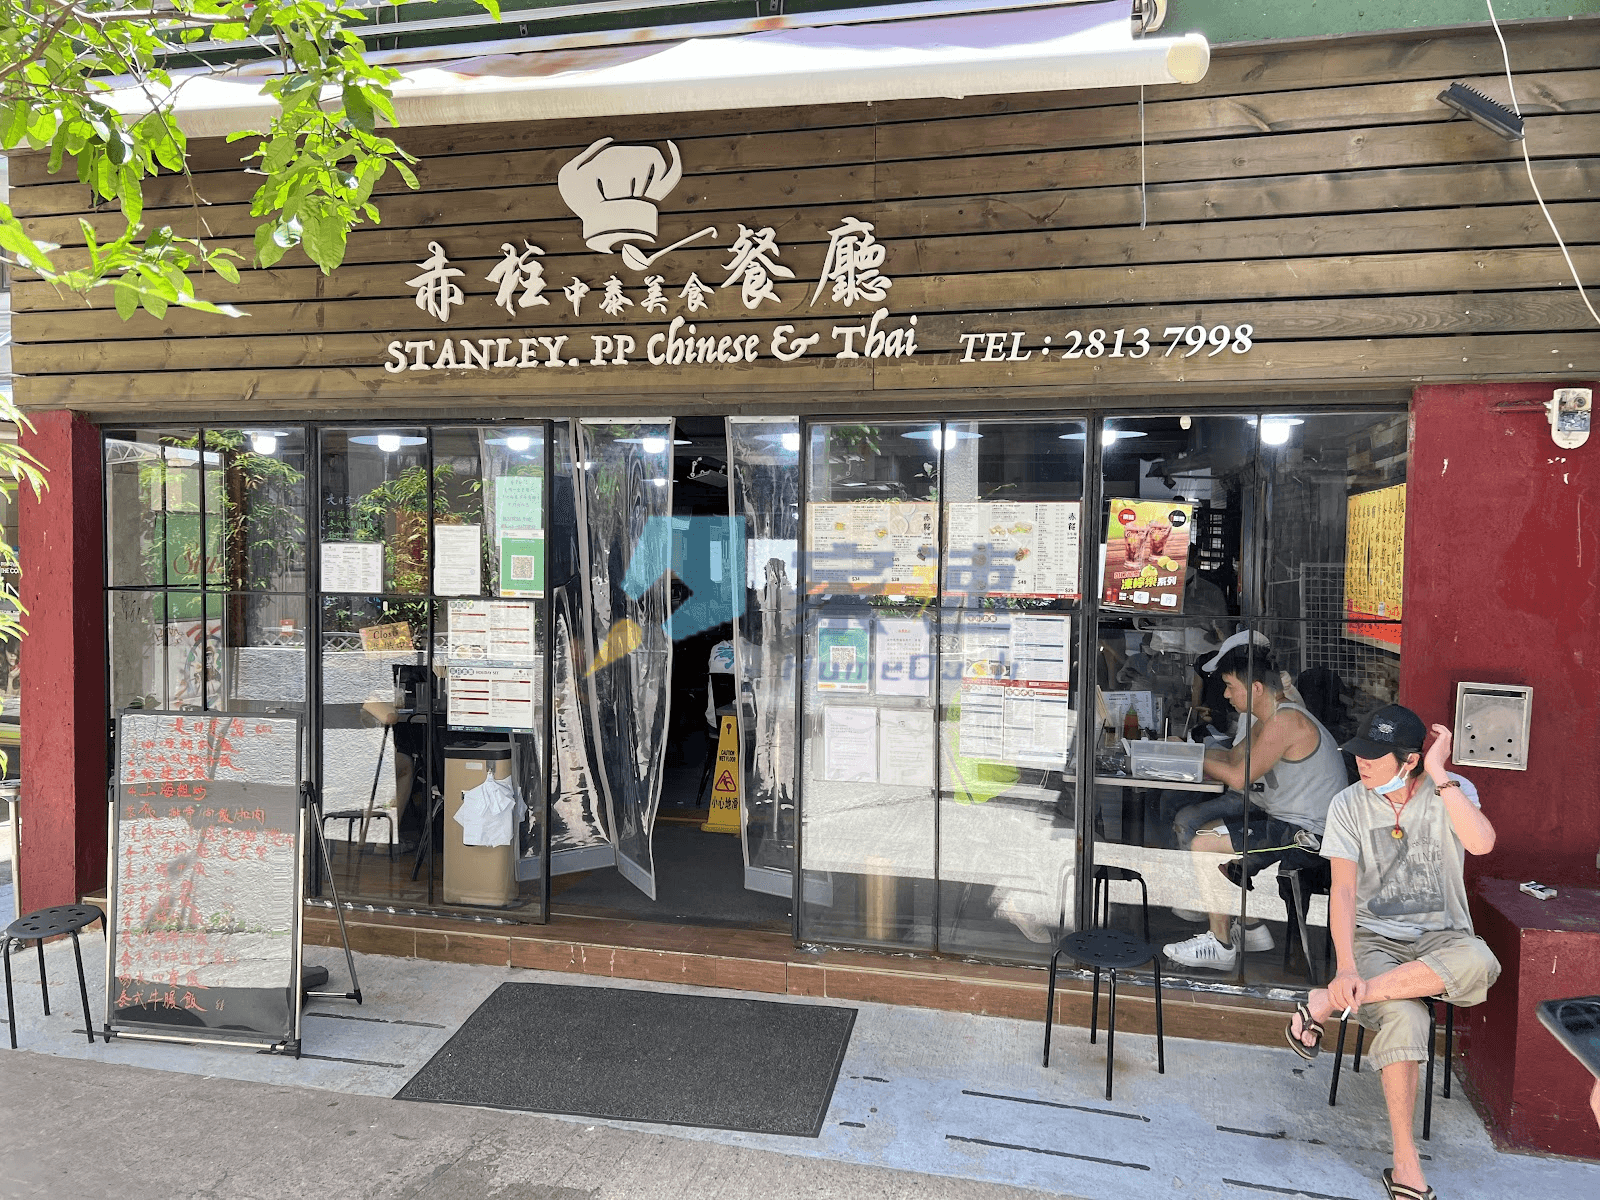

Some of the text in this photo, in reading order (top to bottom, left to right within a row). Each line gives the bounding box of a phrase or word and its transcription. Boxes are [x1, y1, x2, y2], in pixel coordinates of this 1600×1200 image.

[404, 216, 894, 322] 赤柱 中泰美食 餐廳
[384, 307, 919, 374] STANLEY. PP Chinese & Thai
[958, 331, 1032, 363] TEL
[1060, 327, 1151, 360] 2813
[1162, 323, 1254, 358] 7998
[711, 796, 739, 811] 小心地滑
